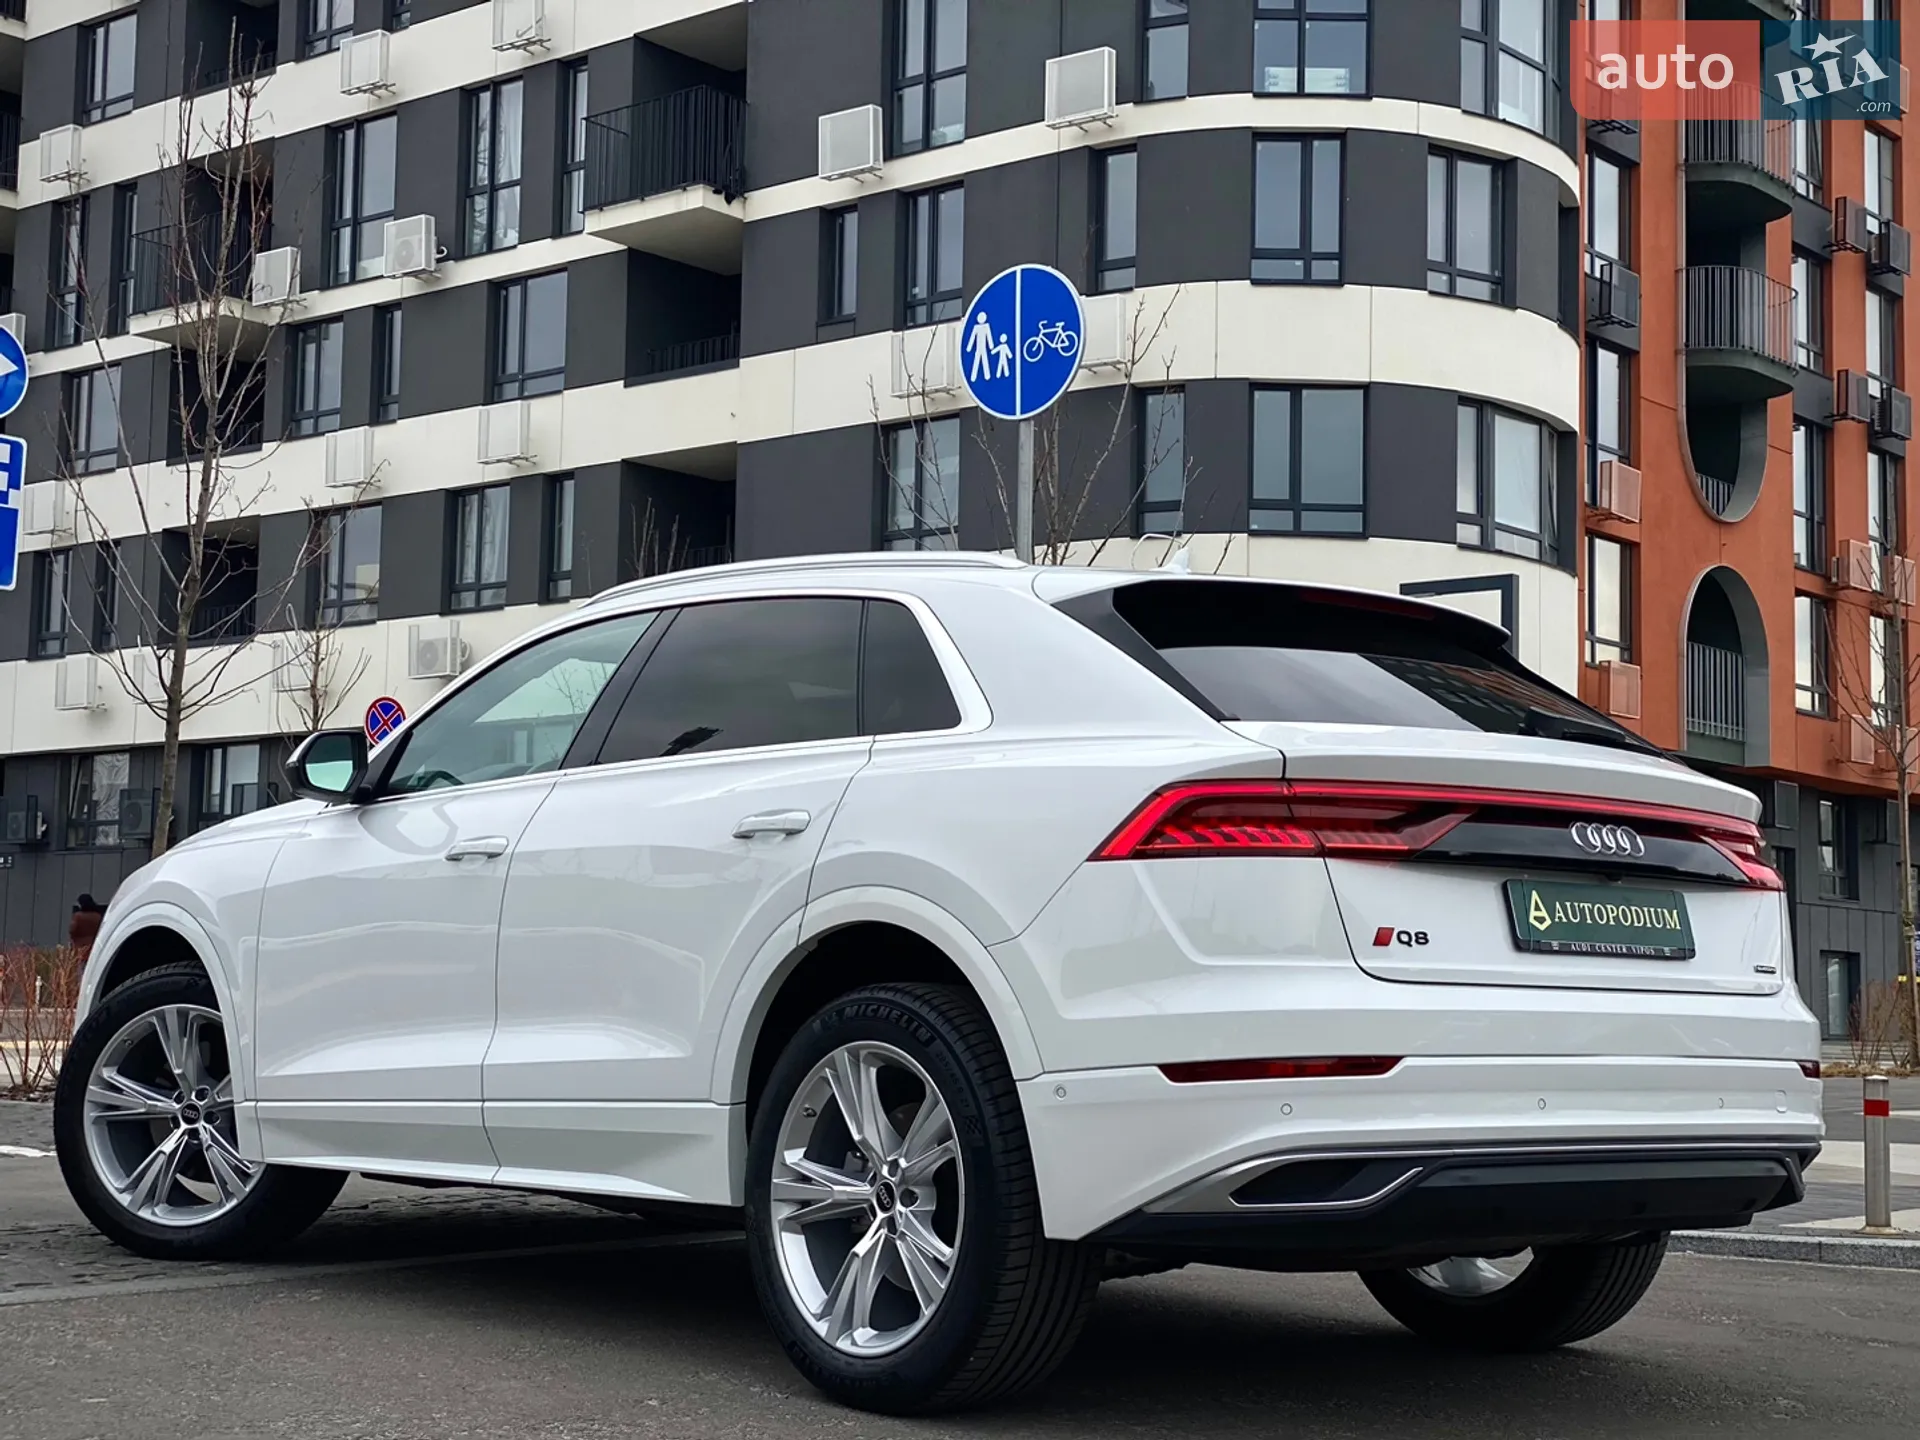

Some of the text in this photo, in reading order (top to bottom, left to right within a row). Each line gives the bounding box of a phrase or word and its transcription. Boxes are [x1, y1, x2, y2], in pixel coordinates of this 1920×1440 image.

[1554, 900, 1682, 931] AUTOPODIUM
[1396, 929, 1430, 948] Q8
[1570, 942, 1592, 952] AUDI
[1595, 943, 1628, 954] CENTER
[843, 1004, 932, 1042] MICHELIN
